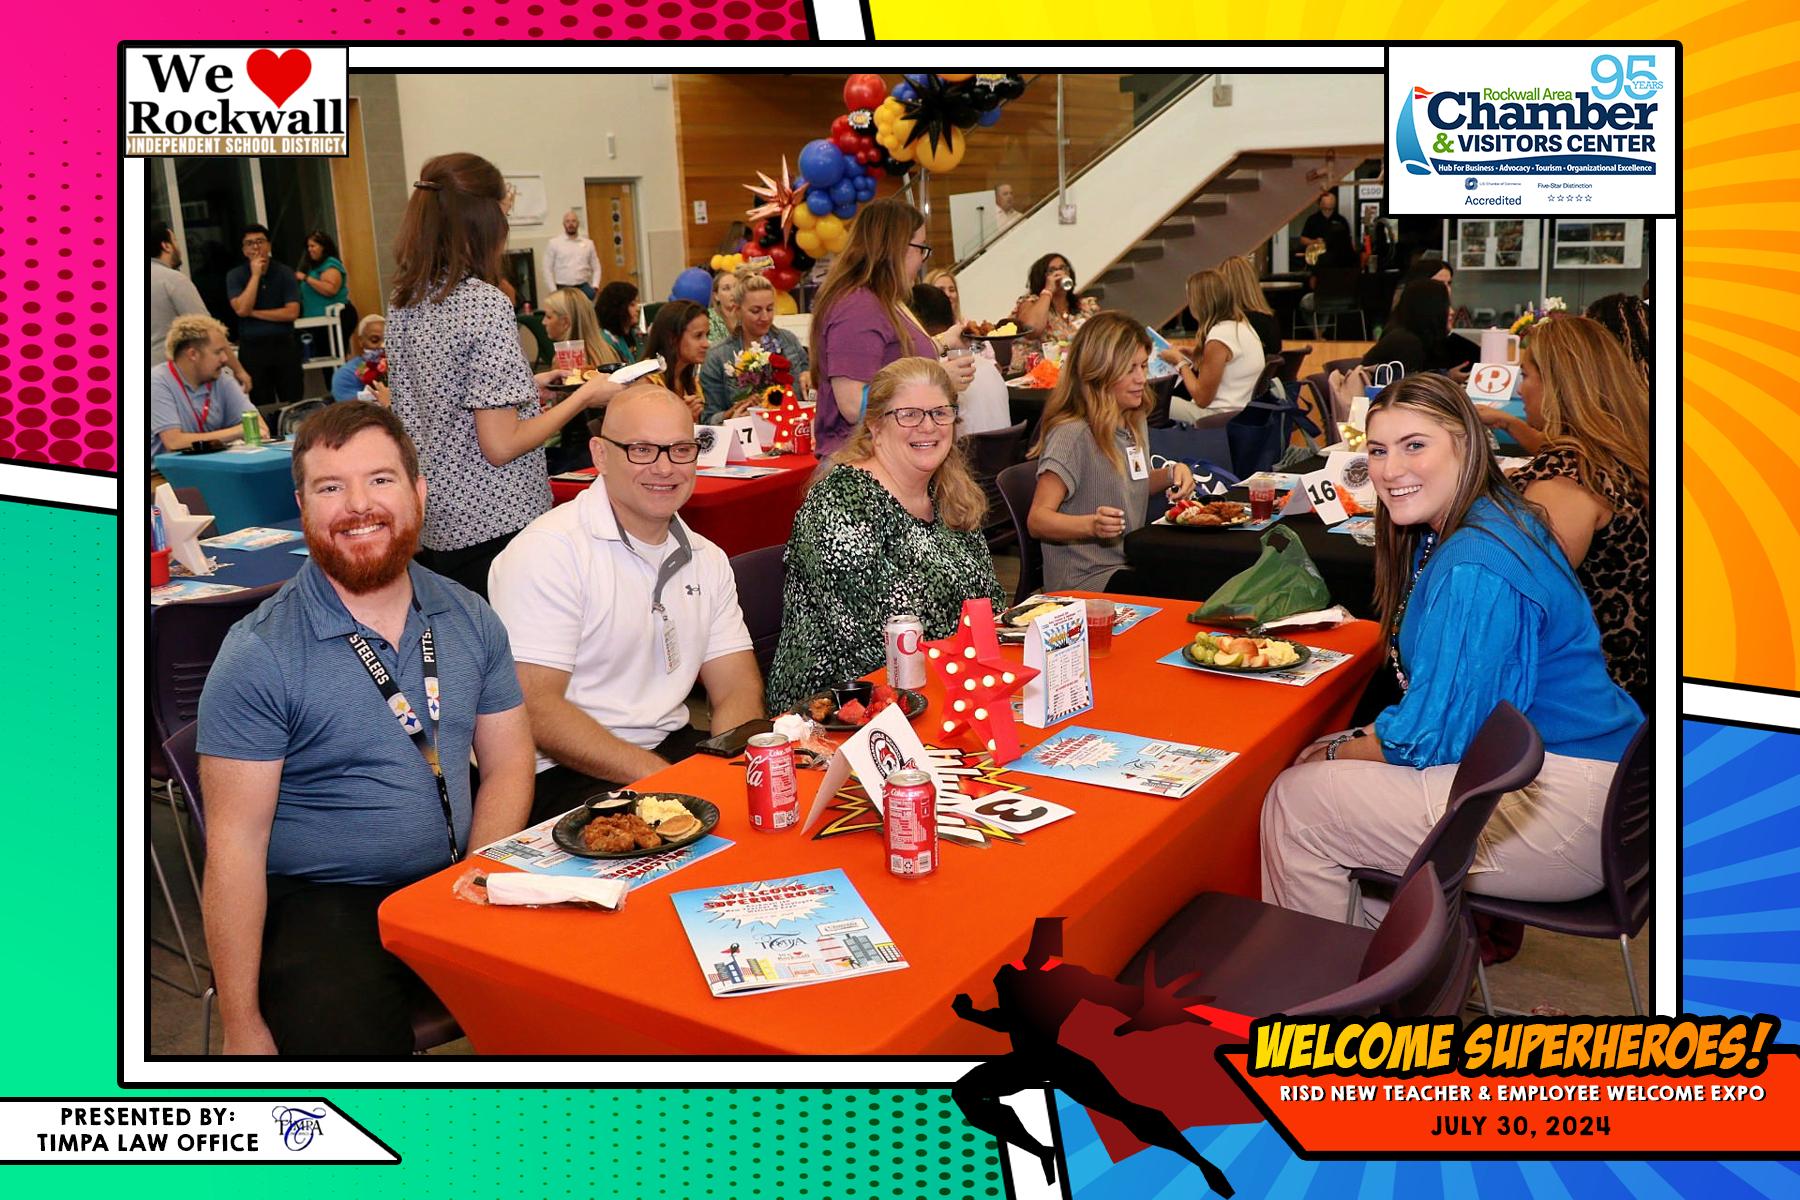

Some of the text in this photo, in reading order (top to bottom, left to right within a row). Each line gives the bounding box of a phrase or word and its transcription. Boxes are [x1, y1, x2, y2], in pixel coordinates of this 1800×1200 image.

[1307, 479, 1338, 506] 16
[421, 627, 435, 663] PITTS
[349, 633, 390, 685] STEELERS
[974, 798, 1049, 823] 3
[703, 885, 835, 909] SUPERHEROES!
[719, 883, 807, 901] WELCOME
